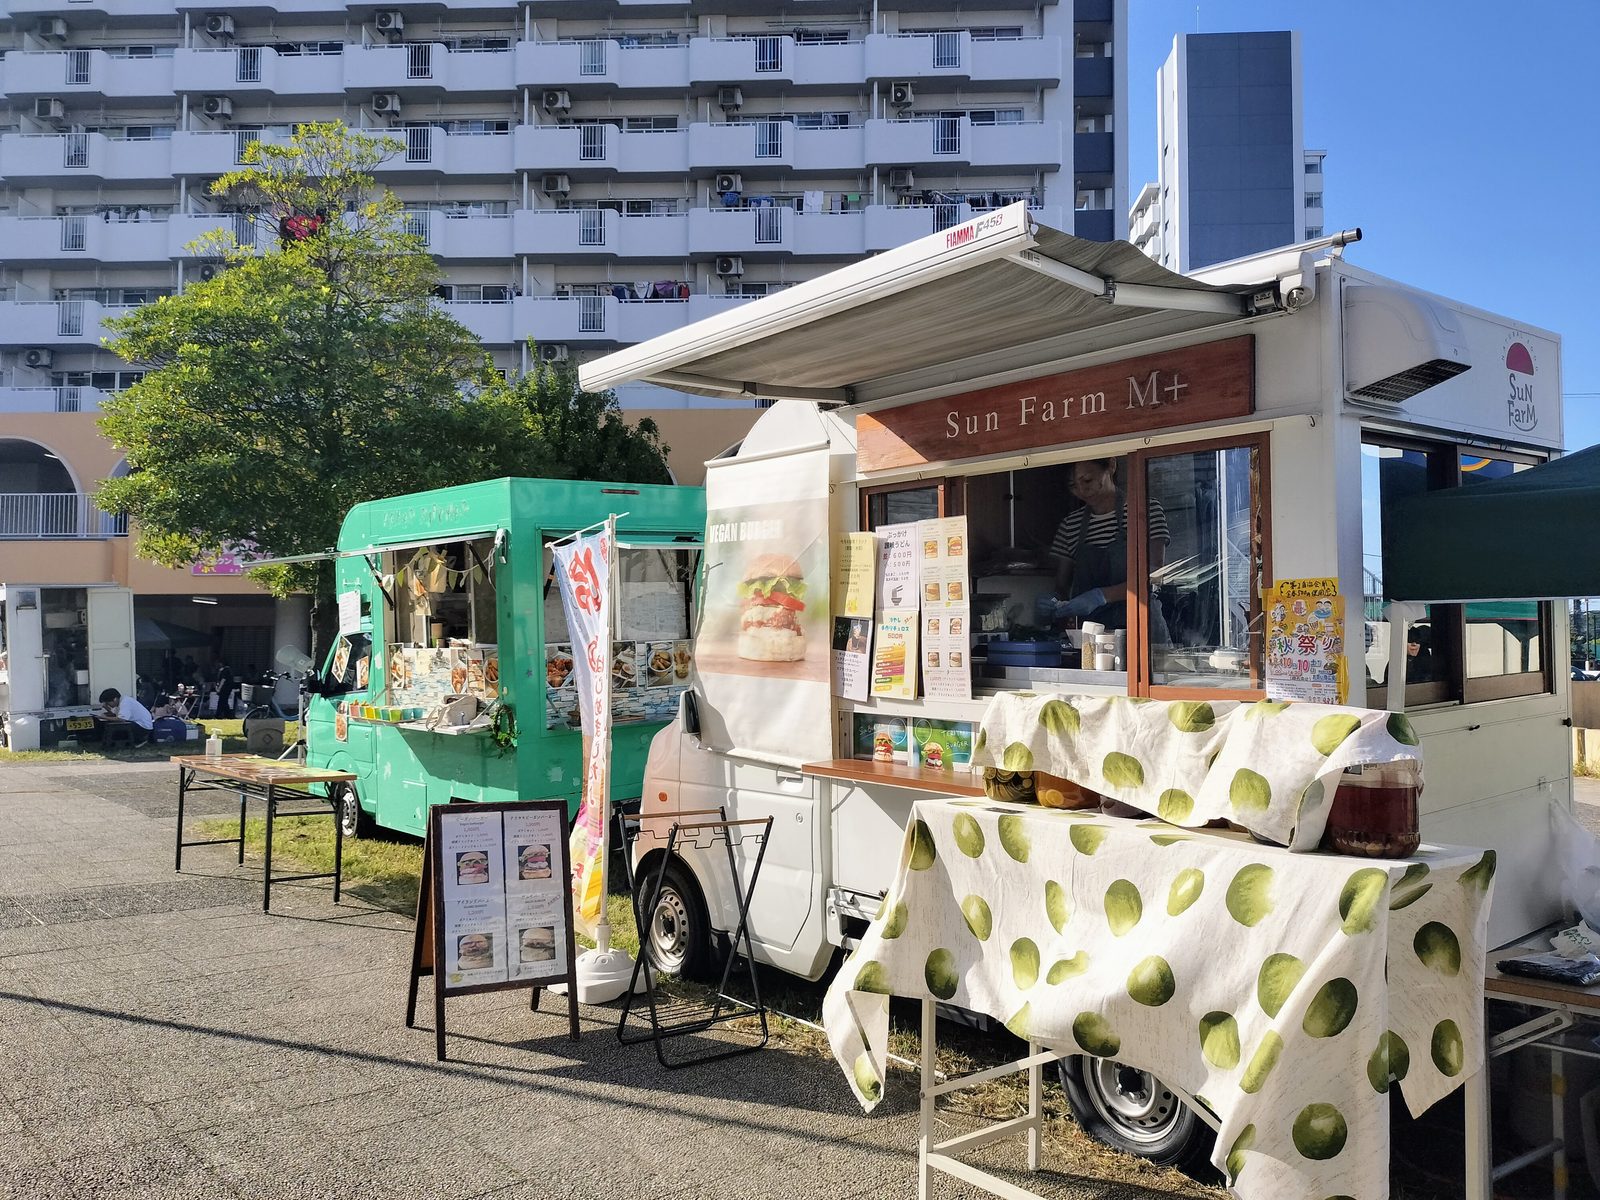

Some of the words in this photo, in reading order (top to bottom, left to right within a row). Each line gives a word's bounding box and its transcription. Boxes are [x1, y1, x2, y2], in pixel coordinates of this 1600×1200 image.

[946, 225, 974, 249] FIAMMA
[946, 411, 999, 439] Sun
[1019, 390, 1107, 426] Farm
[1125, 370, 1188, 410] M+
[709, 522, 738, 544] VEGAN
[1276, 635, 1334, 655] 秋祭り
